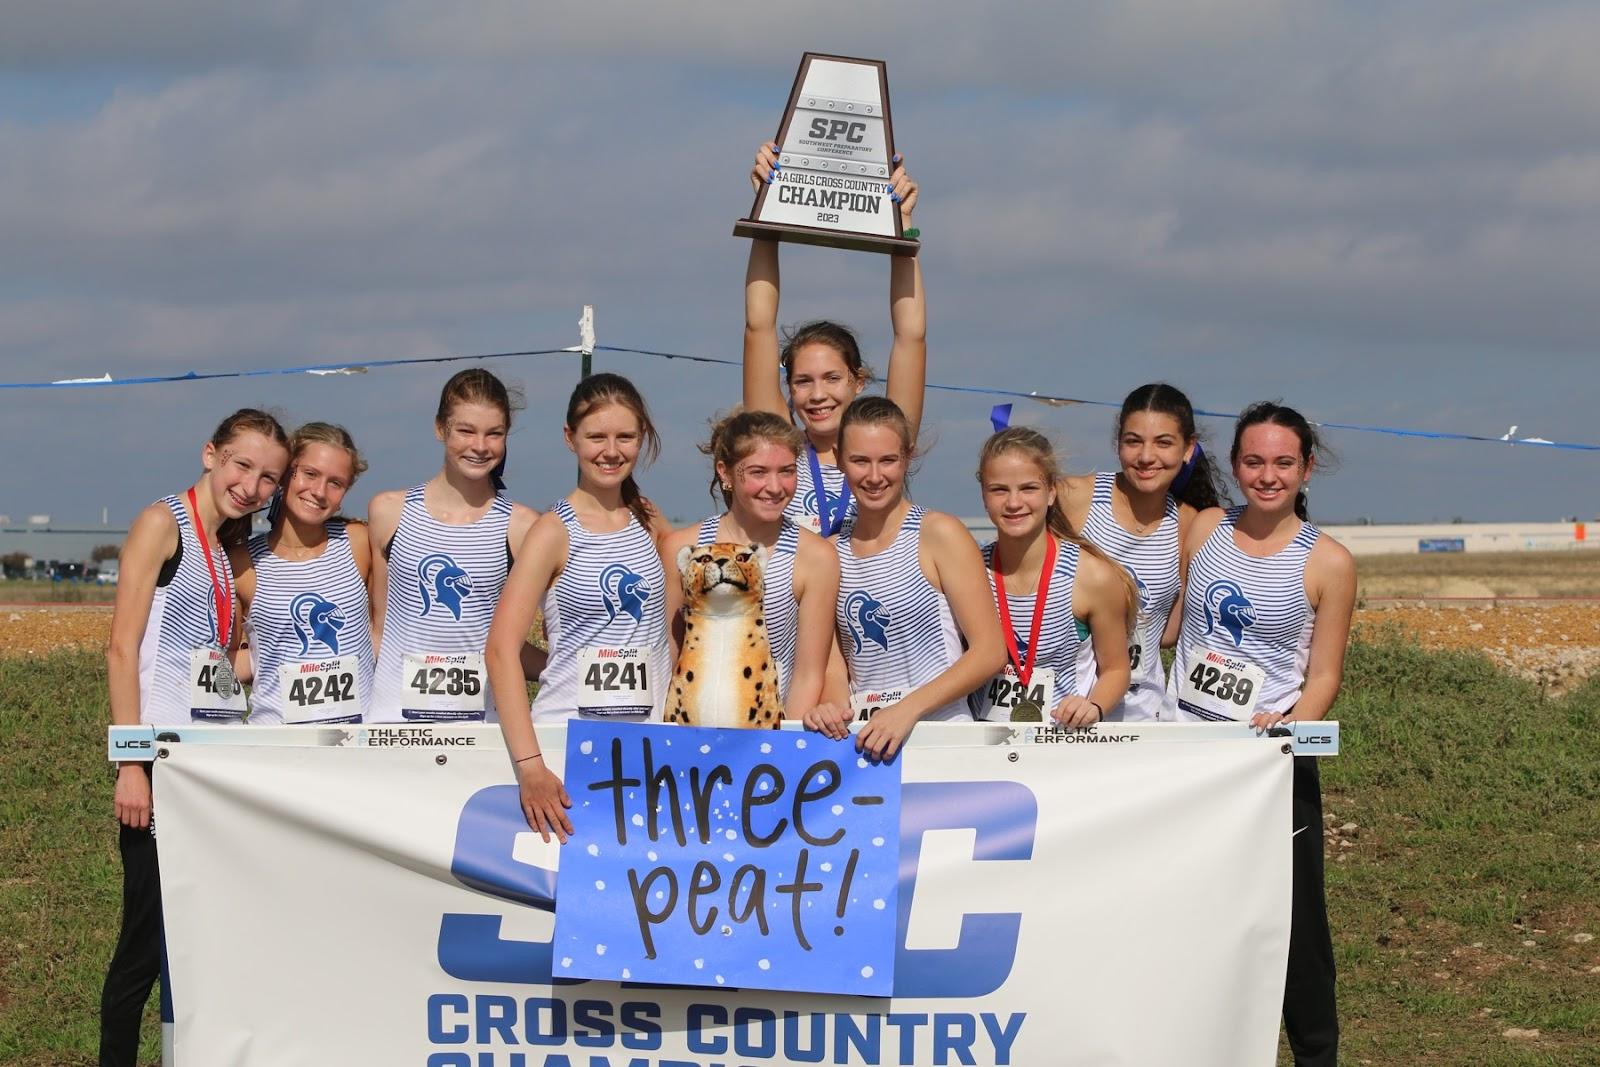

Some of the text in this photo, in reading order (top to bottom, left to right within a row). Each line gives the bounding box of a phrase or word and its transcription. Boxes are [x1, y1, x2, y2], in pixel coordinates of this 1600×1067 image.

[808, 117, 867, 144] SPC
[799, 139, 873, 153] SOUTHWEST PREPARATORY
[816, 147, 853, 156] CONFERENCE
[789, 172, 815, 186] GIRLS
[815, 175, 844, 189] CROSS
[844, 179, 888, 194] COUNTRY
[778, 184, 882, 214] CHAMPION
[816, 212, 840, 223] 2023
[425, 655, 467, 665] MileSplit
[598, 648, 638, 660] MileSplit
[1206, 652, 1246, 673] MileSplit
[299, 660, 341, 675] MileSplit
[585, 662, 647, 691] 4241
[288, 672, 355, 706] 4242
[411, 667, 481, 696] 4235
[1189, 662, 1254, 706] 4239
[866, 690, 902, 703] MileSplit
[988, 678, 1046, 712] 4234
[115, 740, 151, 749] UCS
[1297, 735, 1332, 745] UCS
[587, 737, 885, 849] three-
[437, 780, 1038, 1000] SC
[627, 847, 859, 960] peat!
[427, 993, 1027, 1066] CROSS COUNTRY
